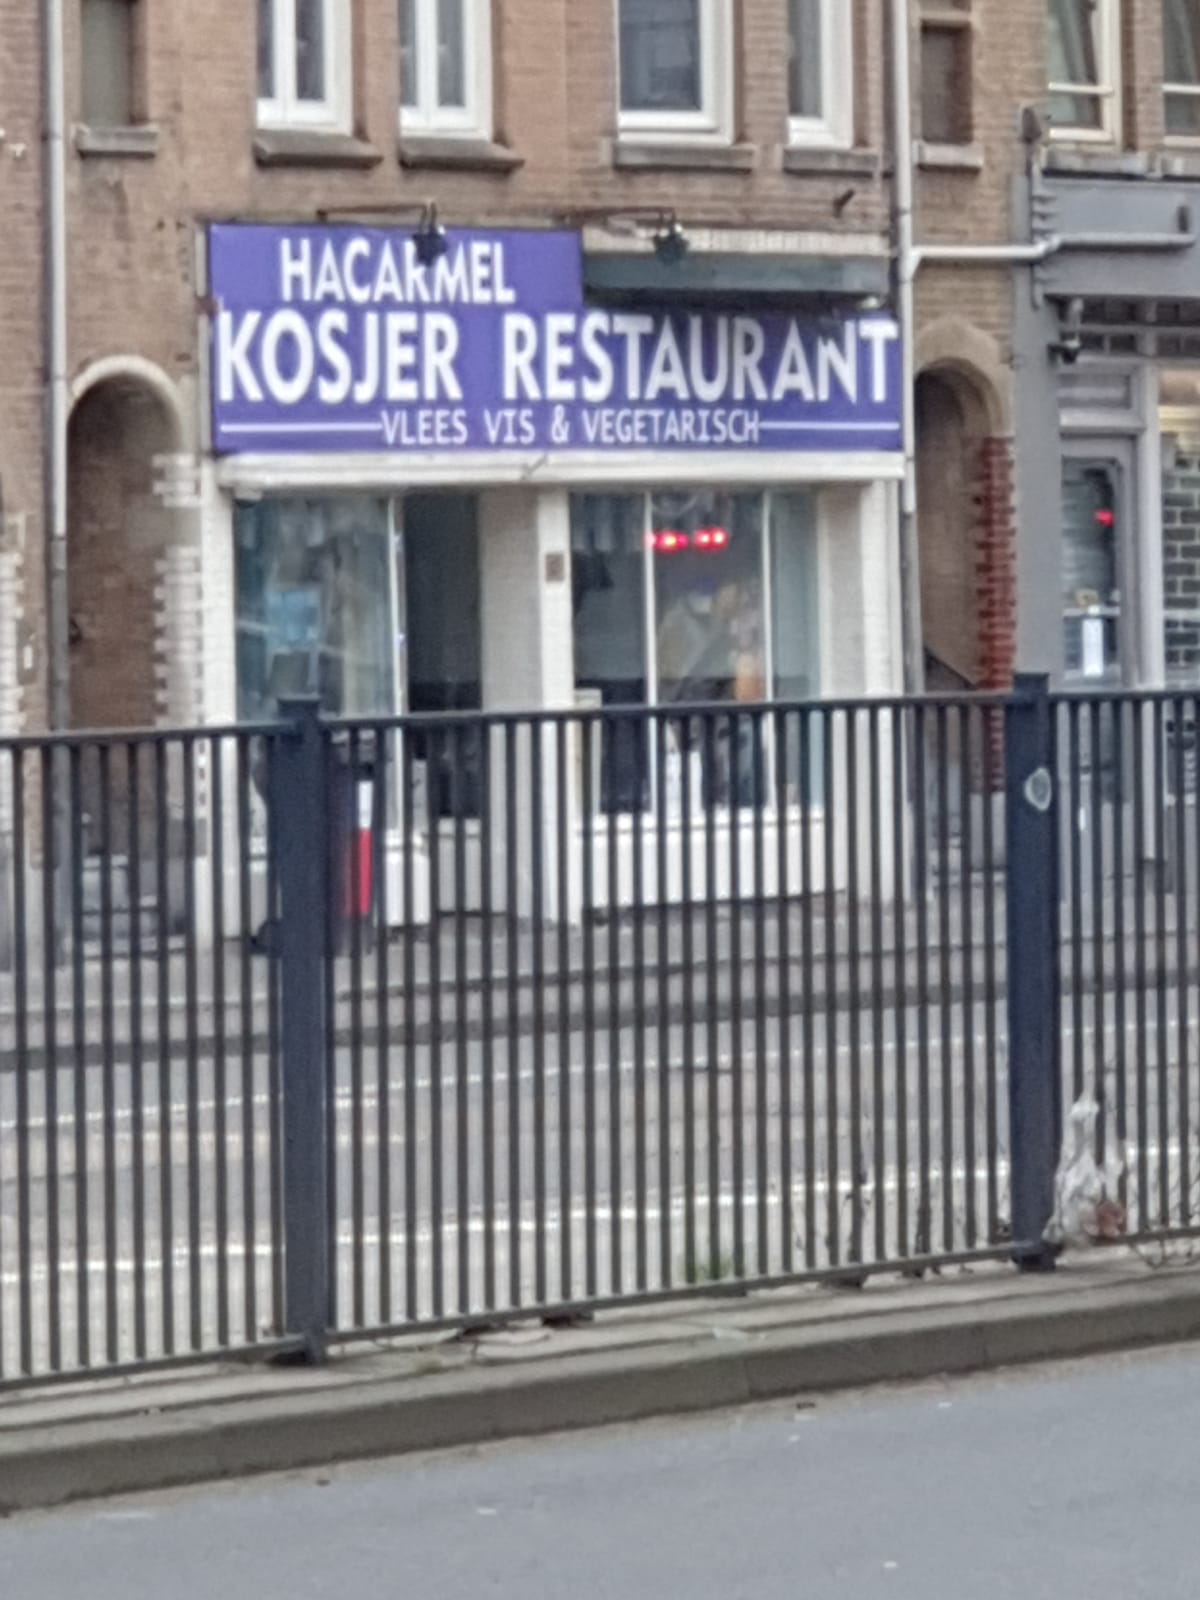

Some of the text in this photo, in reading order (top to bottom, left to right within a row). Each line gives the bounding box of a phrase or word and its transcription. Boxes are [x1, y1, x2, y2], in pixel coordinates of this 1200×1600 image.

[217, 308, 900, 404] KOSJER RESTAURANT
[380, 405, 760, 446] VLEES VIS & VEGETARISCH
